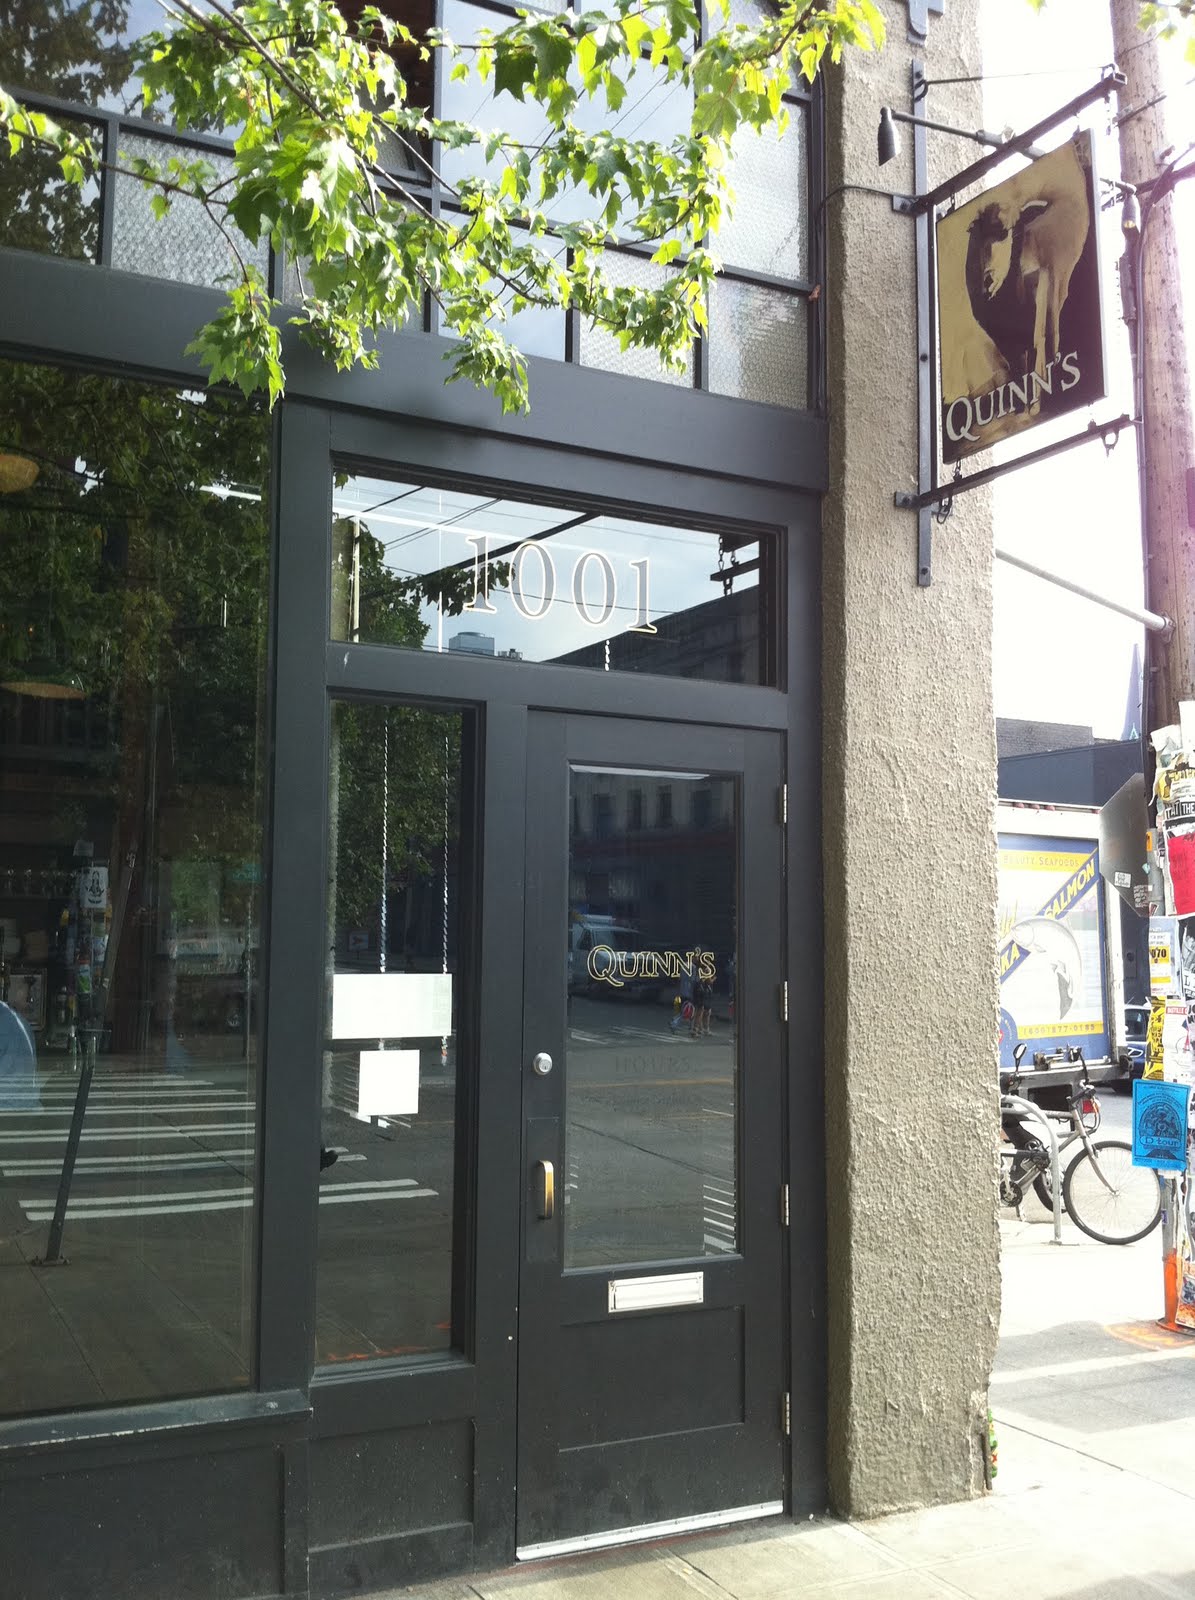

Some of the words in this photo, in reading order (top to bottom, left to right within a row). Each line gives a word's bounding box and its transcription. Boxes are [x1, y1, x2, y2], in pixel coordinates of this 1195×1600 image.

[946, 351, 1081, 442] QUINN'S
[463, 535, 657, 634] 1001
[1044, 858, 1095, 921] SALMON
[587, 945, 716, 987] QUINN'S
